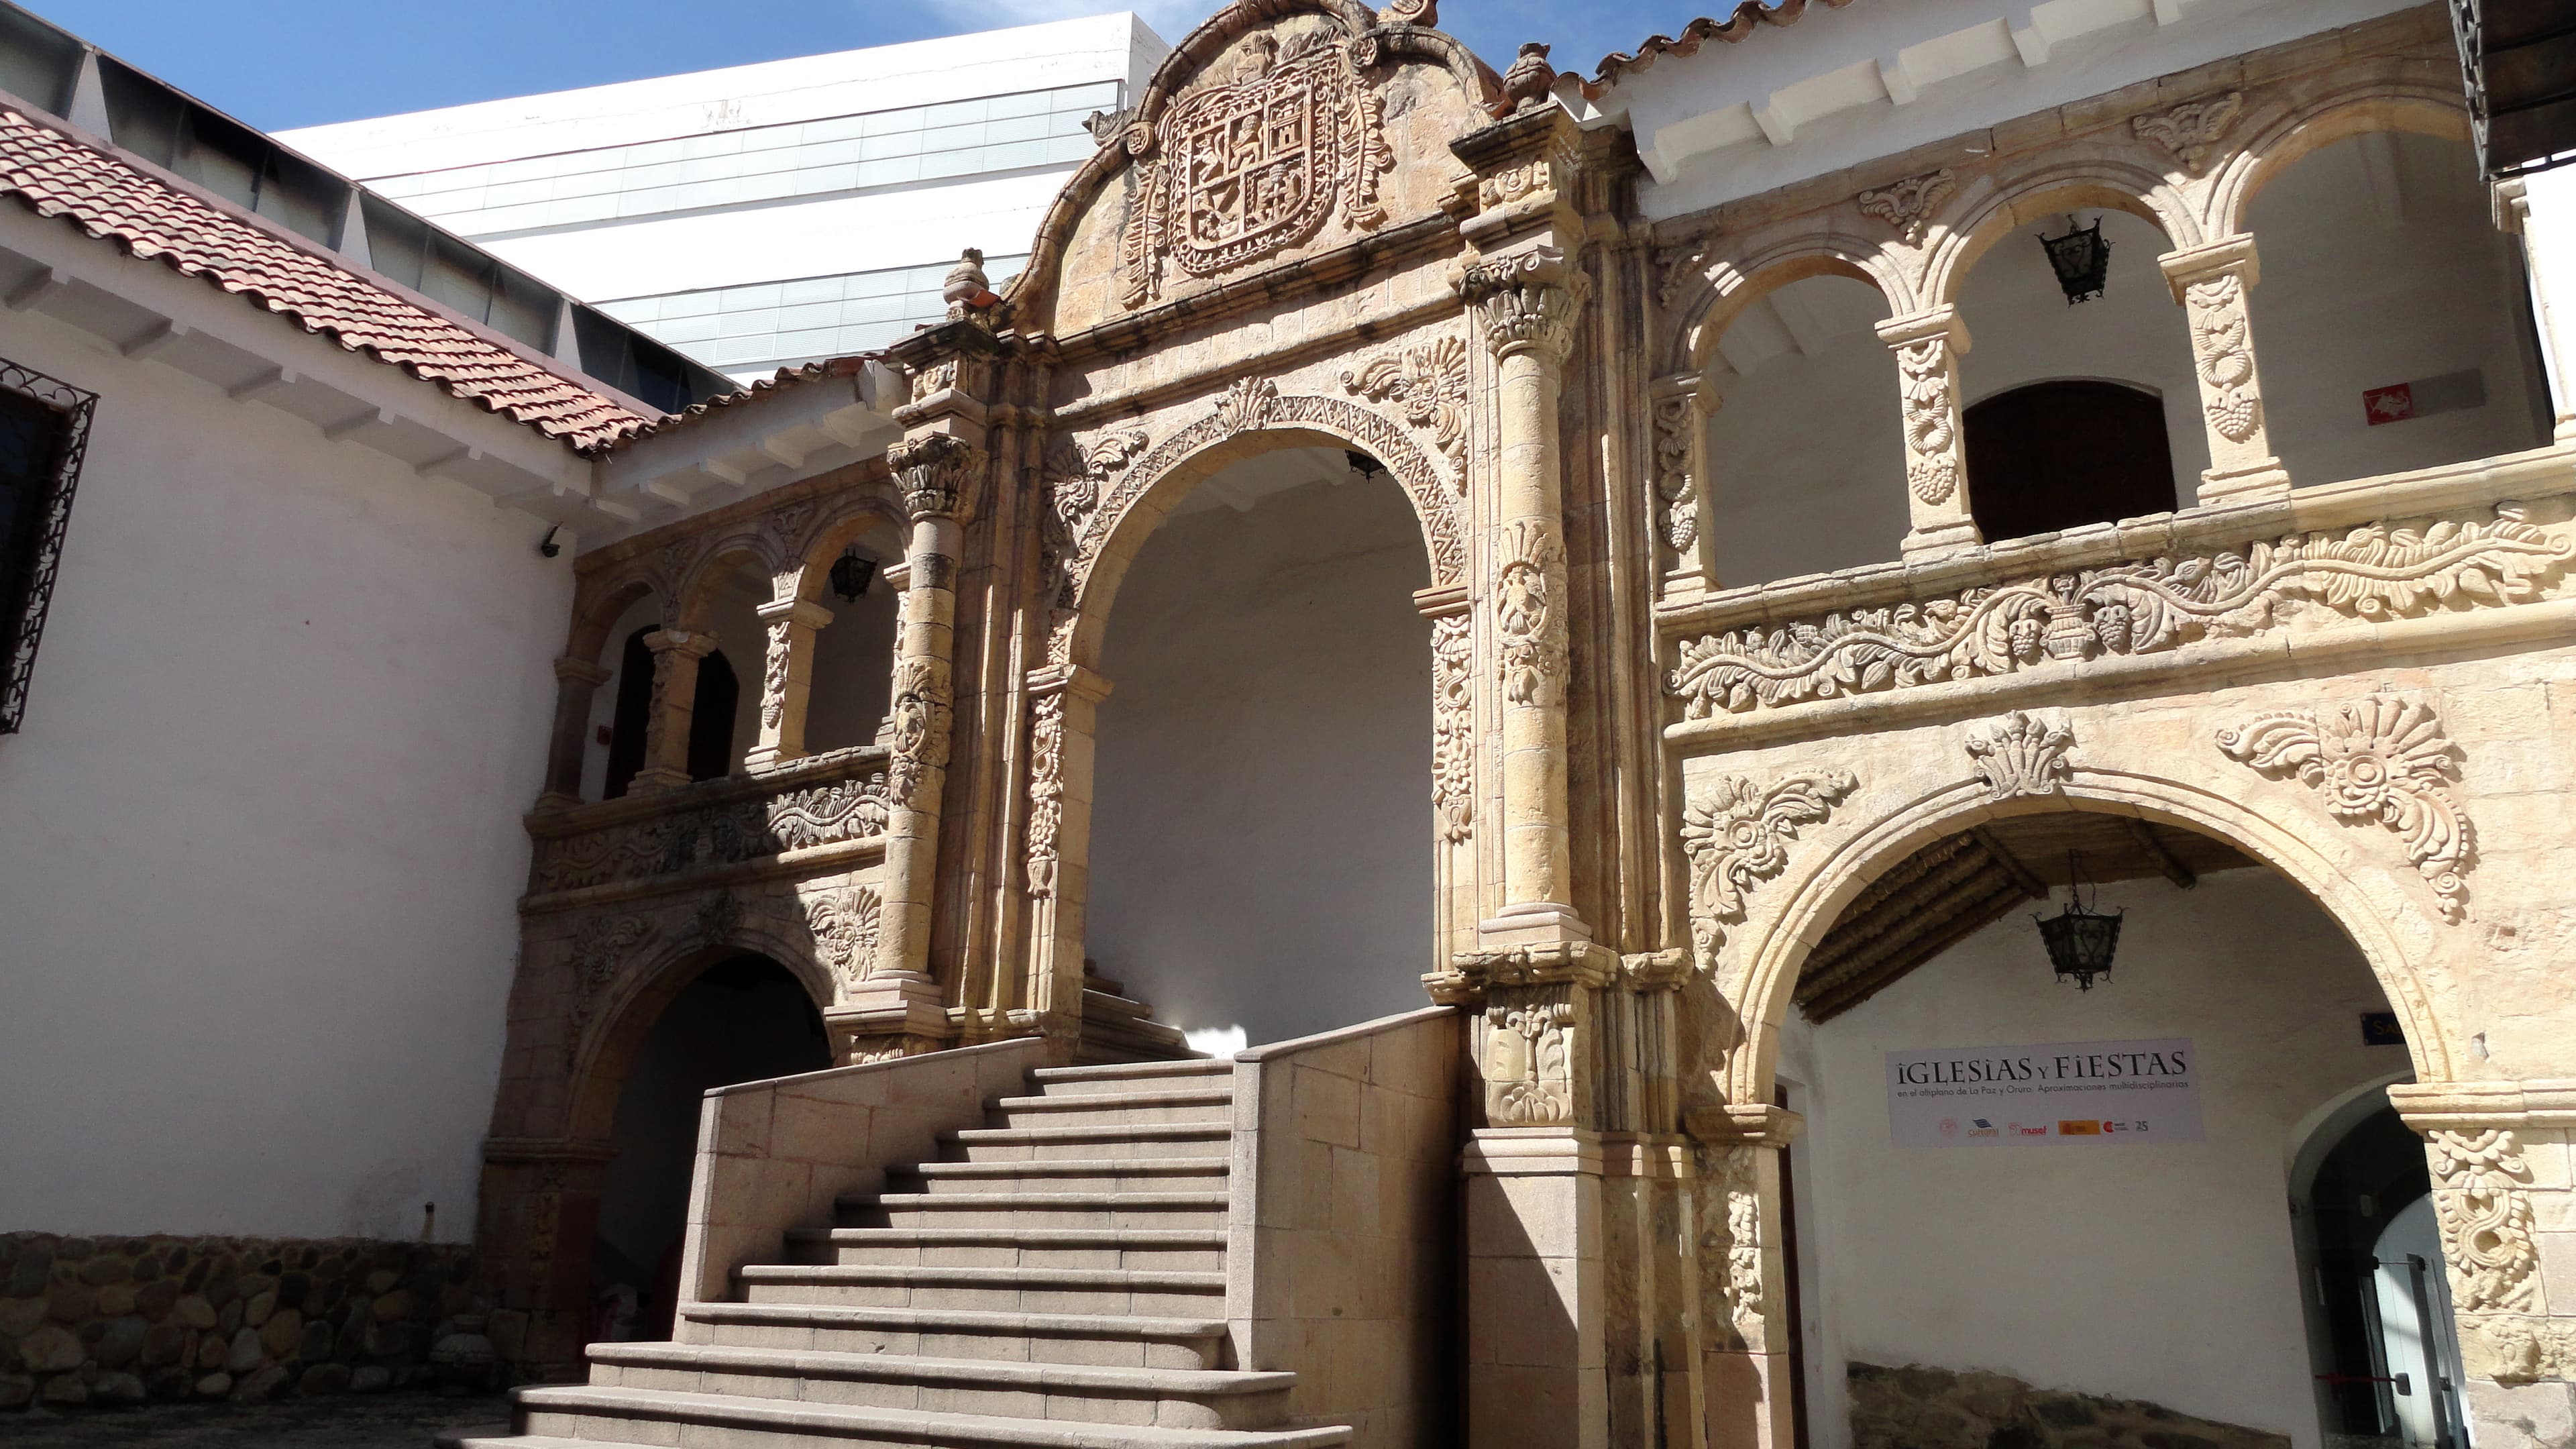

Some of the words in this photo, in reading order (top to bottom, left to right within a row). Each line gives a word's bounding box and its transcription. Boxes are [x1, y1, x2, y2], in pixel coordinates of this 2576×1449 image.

[1910, 1088, 1917, 1097] el
[1919, 1087, 1955, 1098] altiplano
[1956, 1086, 1967, 1095] de
[1970, 1087, 1979, 1095] La
[1981, 1085, 1997, 1094] Paz
[2037, 1083, 2106, 1094] Aproximaciones
[2108, 1080, 2190, 1091] multidisciplinarias
